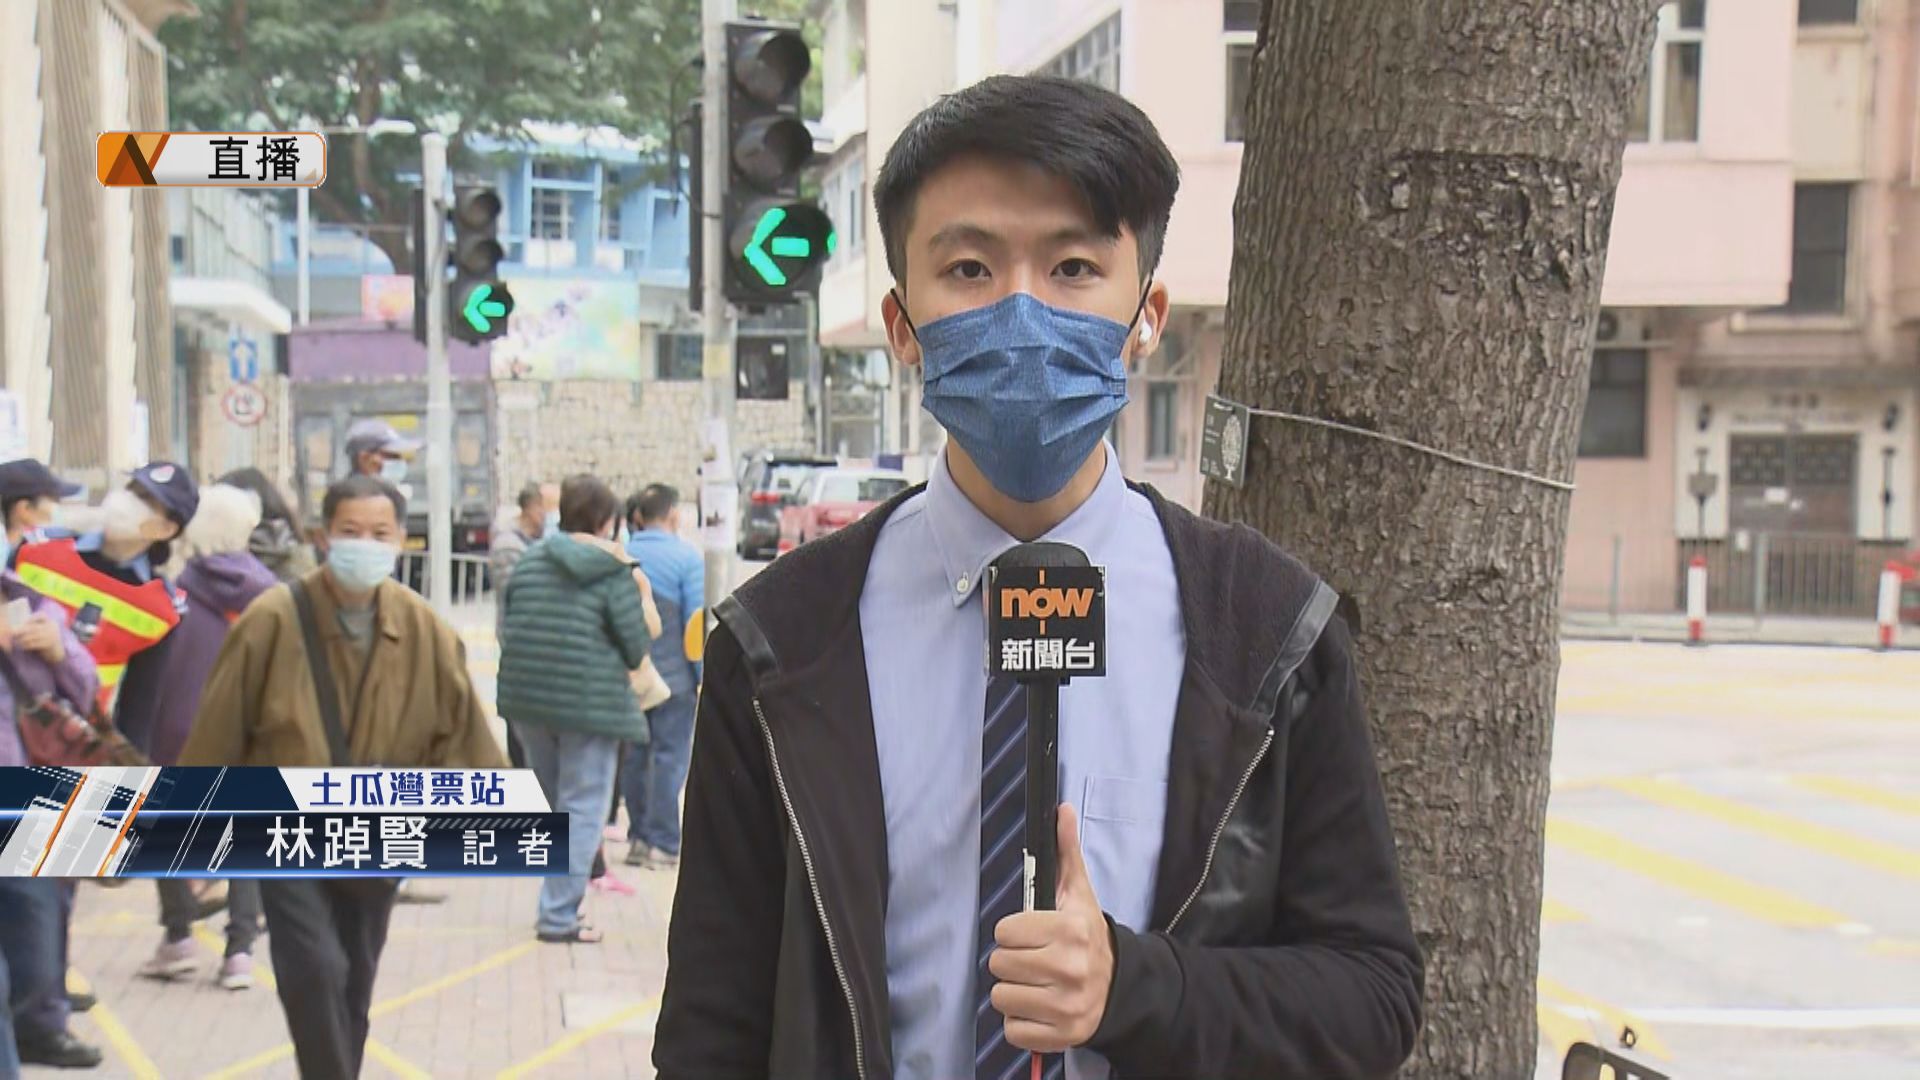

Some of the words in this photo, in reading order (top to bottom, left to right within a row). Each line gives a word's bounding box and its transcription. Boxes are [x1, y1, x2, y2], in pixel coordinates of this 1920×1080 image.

[1001, 588, 1094, 618] now
[1001, 638, 1095, 670] 新聞台
